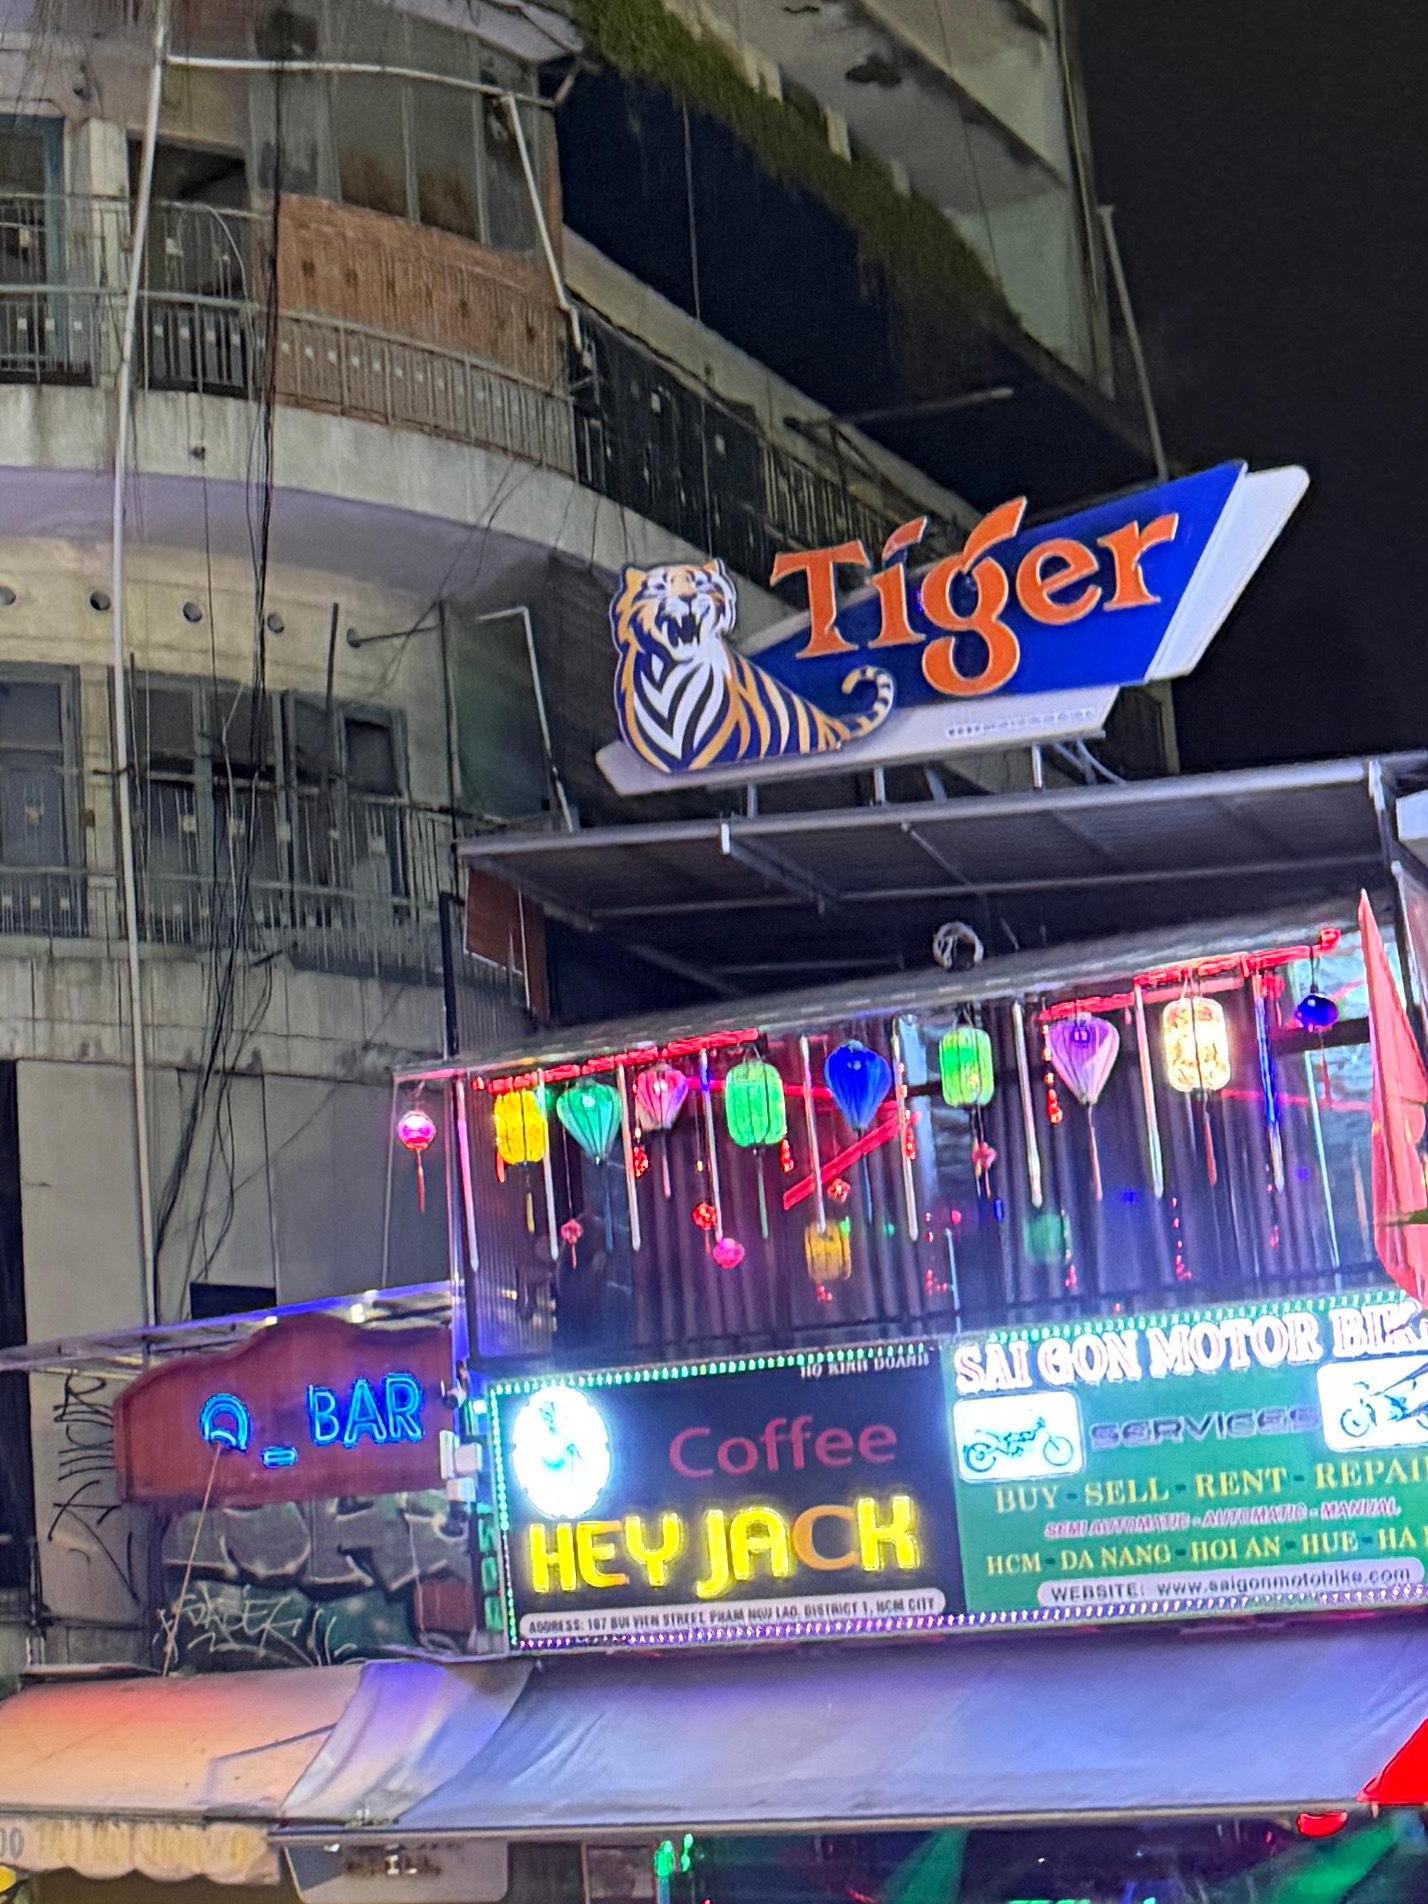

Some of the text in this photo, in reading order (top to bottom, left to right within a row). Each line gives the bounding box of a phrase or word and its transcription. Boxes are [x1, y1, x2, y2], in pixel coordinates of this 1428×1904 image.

[770, 496, 1179, 696] Tiger
[954, 1340, 1033, 1395] SAI
[1038, 1329, 1142, 1387] GON
[1147, 1311, 1324, 1380] MOTOR
[306, 1373, 426, 1448] BAR
[1089, 1404, 1321, 1452] SERVICES
[669, 1415, 898, 1479] Coffee
[995, 1485, 1058, 1514] BUY
[1085, 1477, 1169, 1506] SELL
[1195, 1467, 1287, 1497] RENT
[1315, 1456, 1428, 1489] REPAI
[528, 1511, 682, 1593] HEY
[695, 1495, 922, 1599] JACK
[986, 1552, 1042, 1576] HCM
[1060, 1549, 1094, 1570] DA
[1101, 1542, 1171, 1571] NANG
[1192, 1537, 1238, 1563] HOI
[1245, 1535, 1280, 1559] AN
[1301, 1530, 1359, 1554] HUE
[1377, 1526, 1417, 1550] HA
[804, 1600, 857, 1616] DISTRICT
[909, 1596, 935, 1613] CITY
